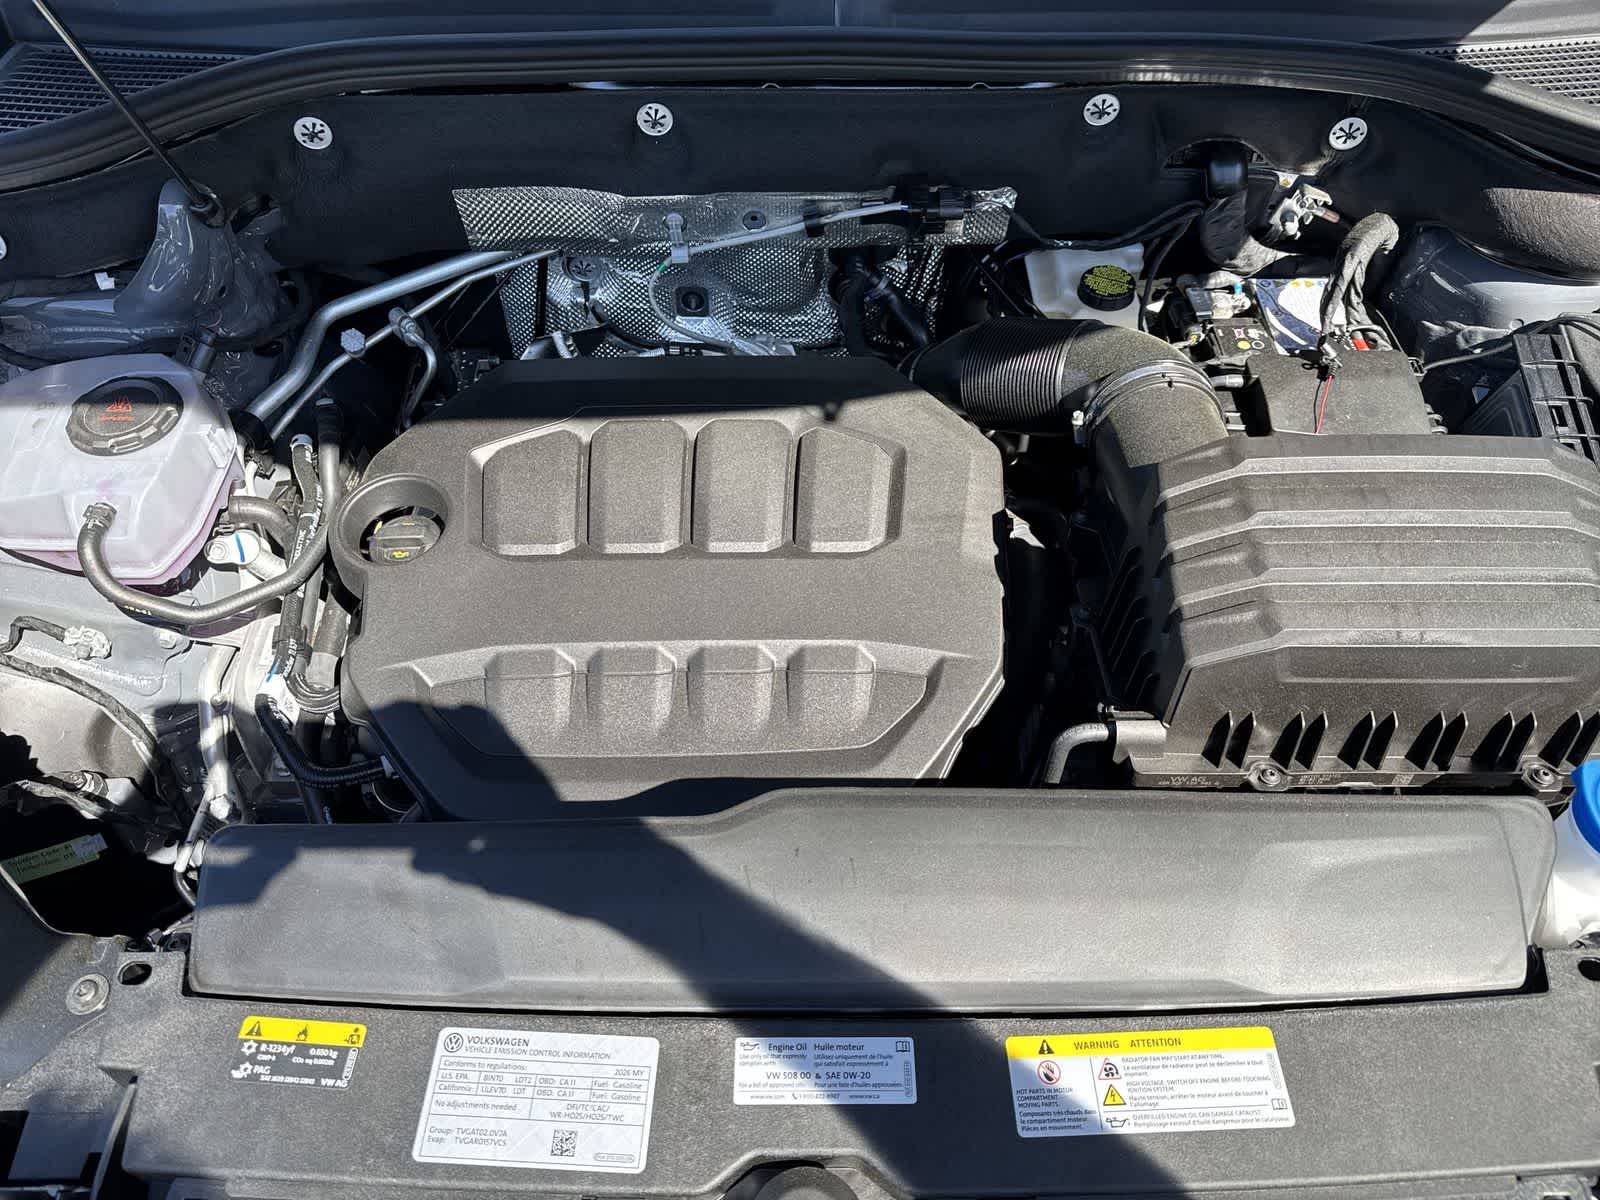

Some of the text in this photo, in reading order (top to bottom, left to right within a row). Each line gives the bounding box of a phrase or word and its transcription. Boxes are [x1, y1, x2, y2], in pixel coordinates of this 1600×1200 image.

[467, 1035, 529, 1047] VOLKSWAGEN
[1073, 1037, 1182, 1051] WARNING ATTENTION
[768, 1042, 807, 1053] Engine Oil
[814, 1043, 865, 1051] Huile moteur
[465, 1045, 611, 1060] VEHICLE EMISSION CONTROL INFORMATION
[835, 1053, 867, 1061] uniquement
[443, 1059, 527, 1071] Conforms to regulations:
[633, 1069, 645, 1077] MY
[766, 1071, 780, 1079] VW
[783, 1071, 798, 1080] 508
[800, 1071, 812, 1080] 00
[825, 1071, 841, 1080] SAE
[843, 1071, 871, 1080] 0W-20
[321, 1078, 335, 1086] VW
[336, 1079, 348, 1088] AG
[612, 1081, 642, 1089] Gasoline
[611, 1093, 641, 1101] Gasoline
[1017, 1094, 1058, 1102] COMPARTMENT
[446, 1100, 490, 1110] adjustments
